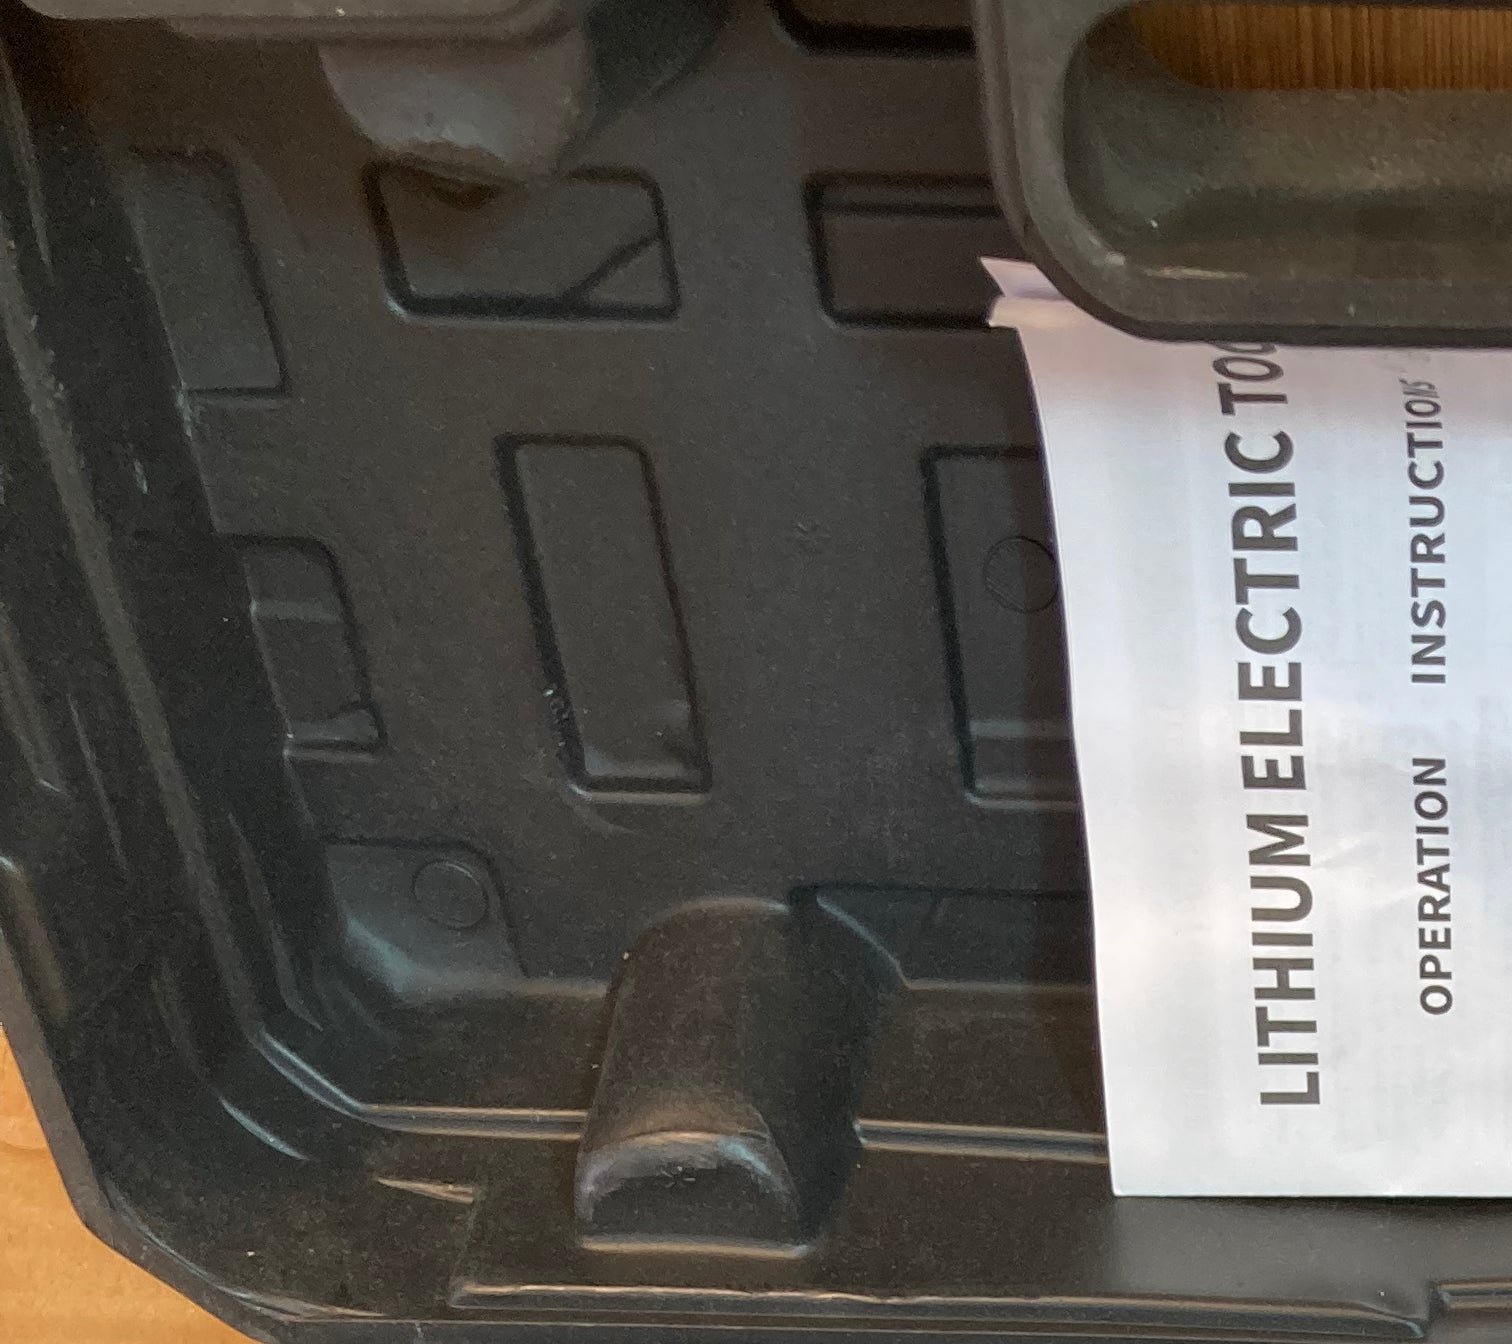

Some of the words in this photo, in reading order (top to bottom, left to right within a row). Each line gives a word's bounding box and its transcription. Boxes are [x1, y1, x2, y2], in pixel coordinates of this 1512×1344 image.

[1224, 431, 1307, 790] ELECTRIC
[1399, 376, 1447, 684] INSTRUCTIONS
[1246, 815, 1320, 1105] LITHIUM
[1412, 757, 1453, 1016] OPERATION
